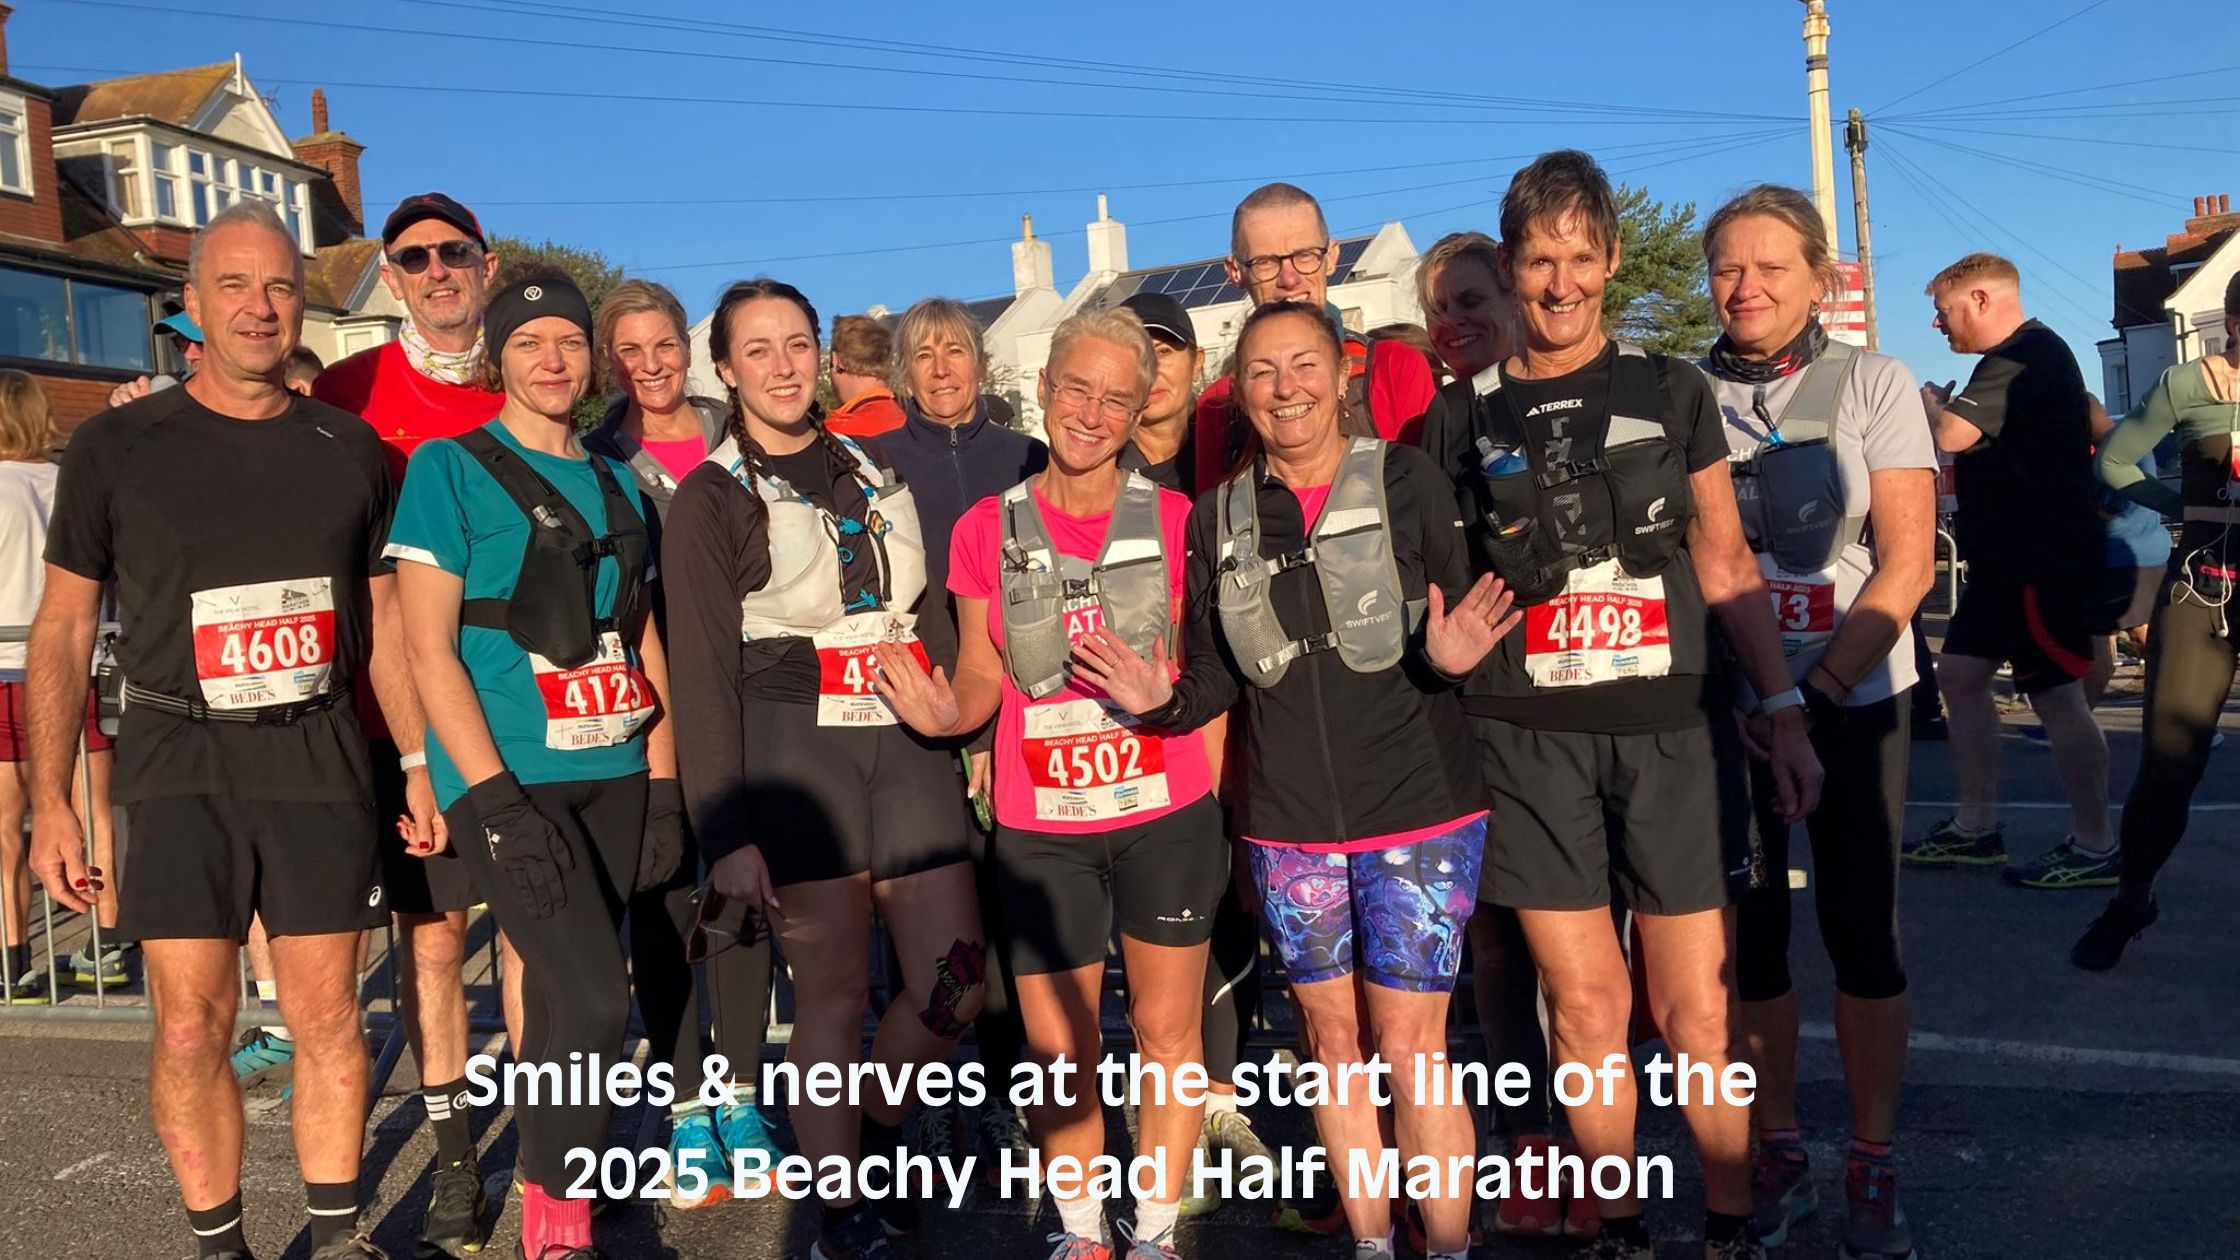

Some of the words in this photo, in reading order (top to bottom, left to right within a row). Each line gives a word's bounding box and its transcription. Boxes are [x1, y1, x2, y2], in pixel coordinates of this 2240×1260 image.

[1539, 398, 1583, 413] TERREX
[1549, 596, 1577, 607] BEACHY
[1580, 595, 1604, 603] HEAD
[1607, 595, 1627, 604] HALF
[217, 622, 253, 633] BEACHY
[254, 619, 278, 630] HEAD
[279, 616, 299, 626] HALF
[299, 614, 316, 623] 2025
[1547, 605, 1643, 649] 4498
[220, 624, 321, 674] 4608
[839, 648, 870, 657] BEACHY
[558, 669, 590, 680] BEACHY
[591, 666, 612, 675] HEAD
[613, 664, 627, 672] HAL
[565, 673, 641, 714] 4123
[1044, 739, 1074, 747] BEACHY
[1075, 735, 1098, 744] HEAD
[1100, 731, 1120, 741] HALF
[1047, 738, 1143, 787] 4502
